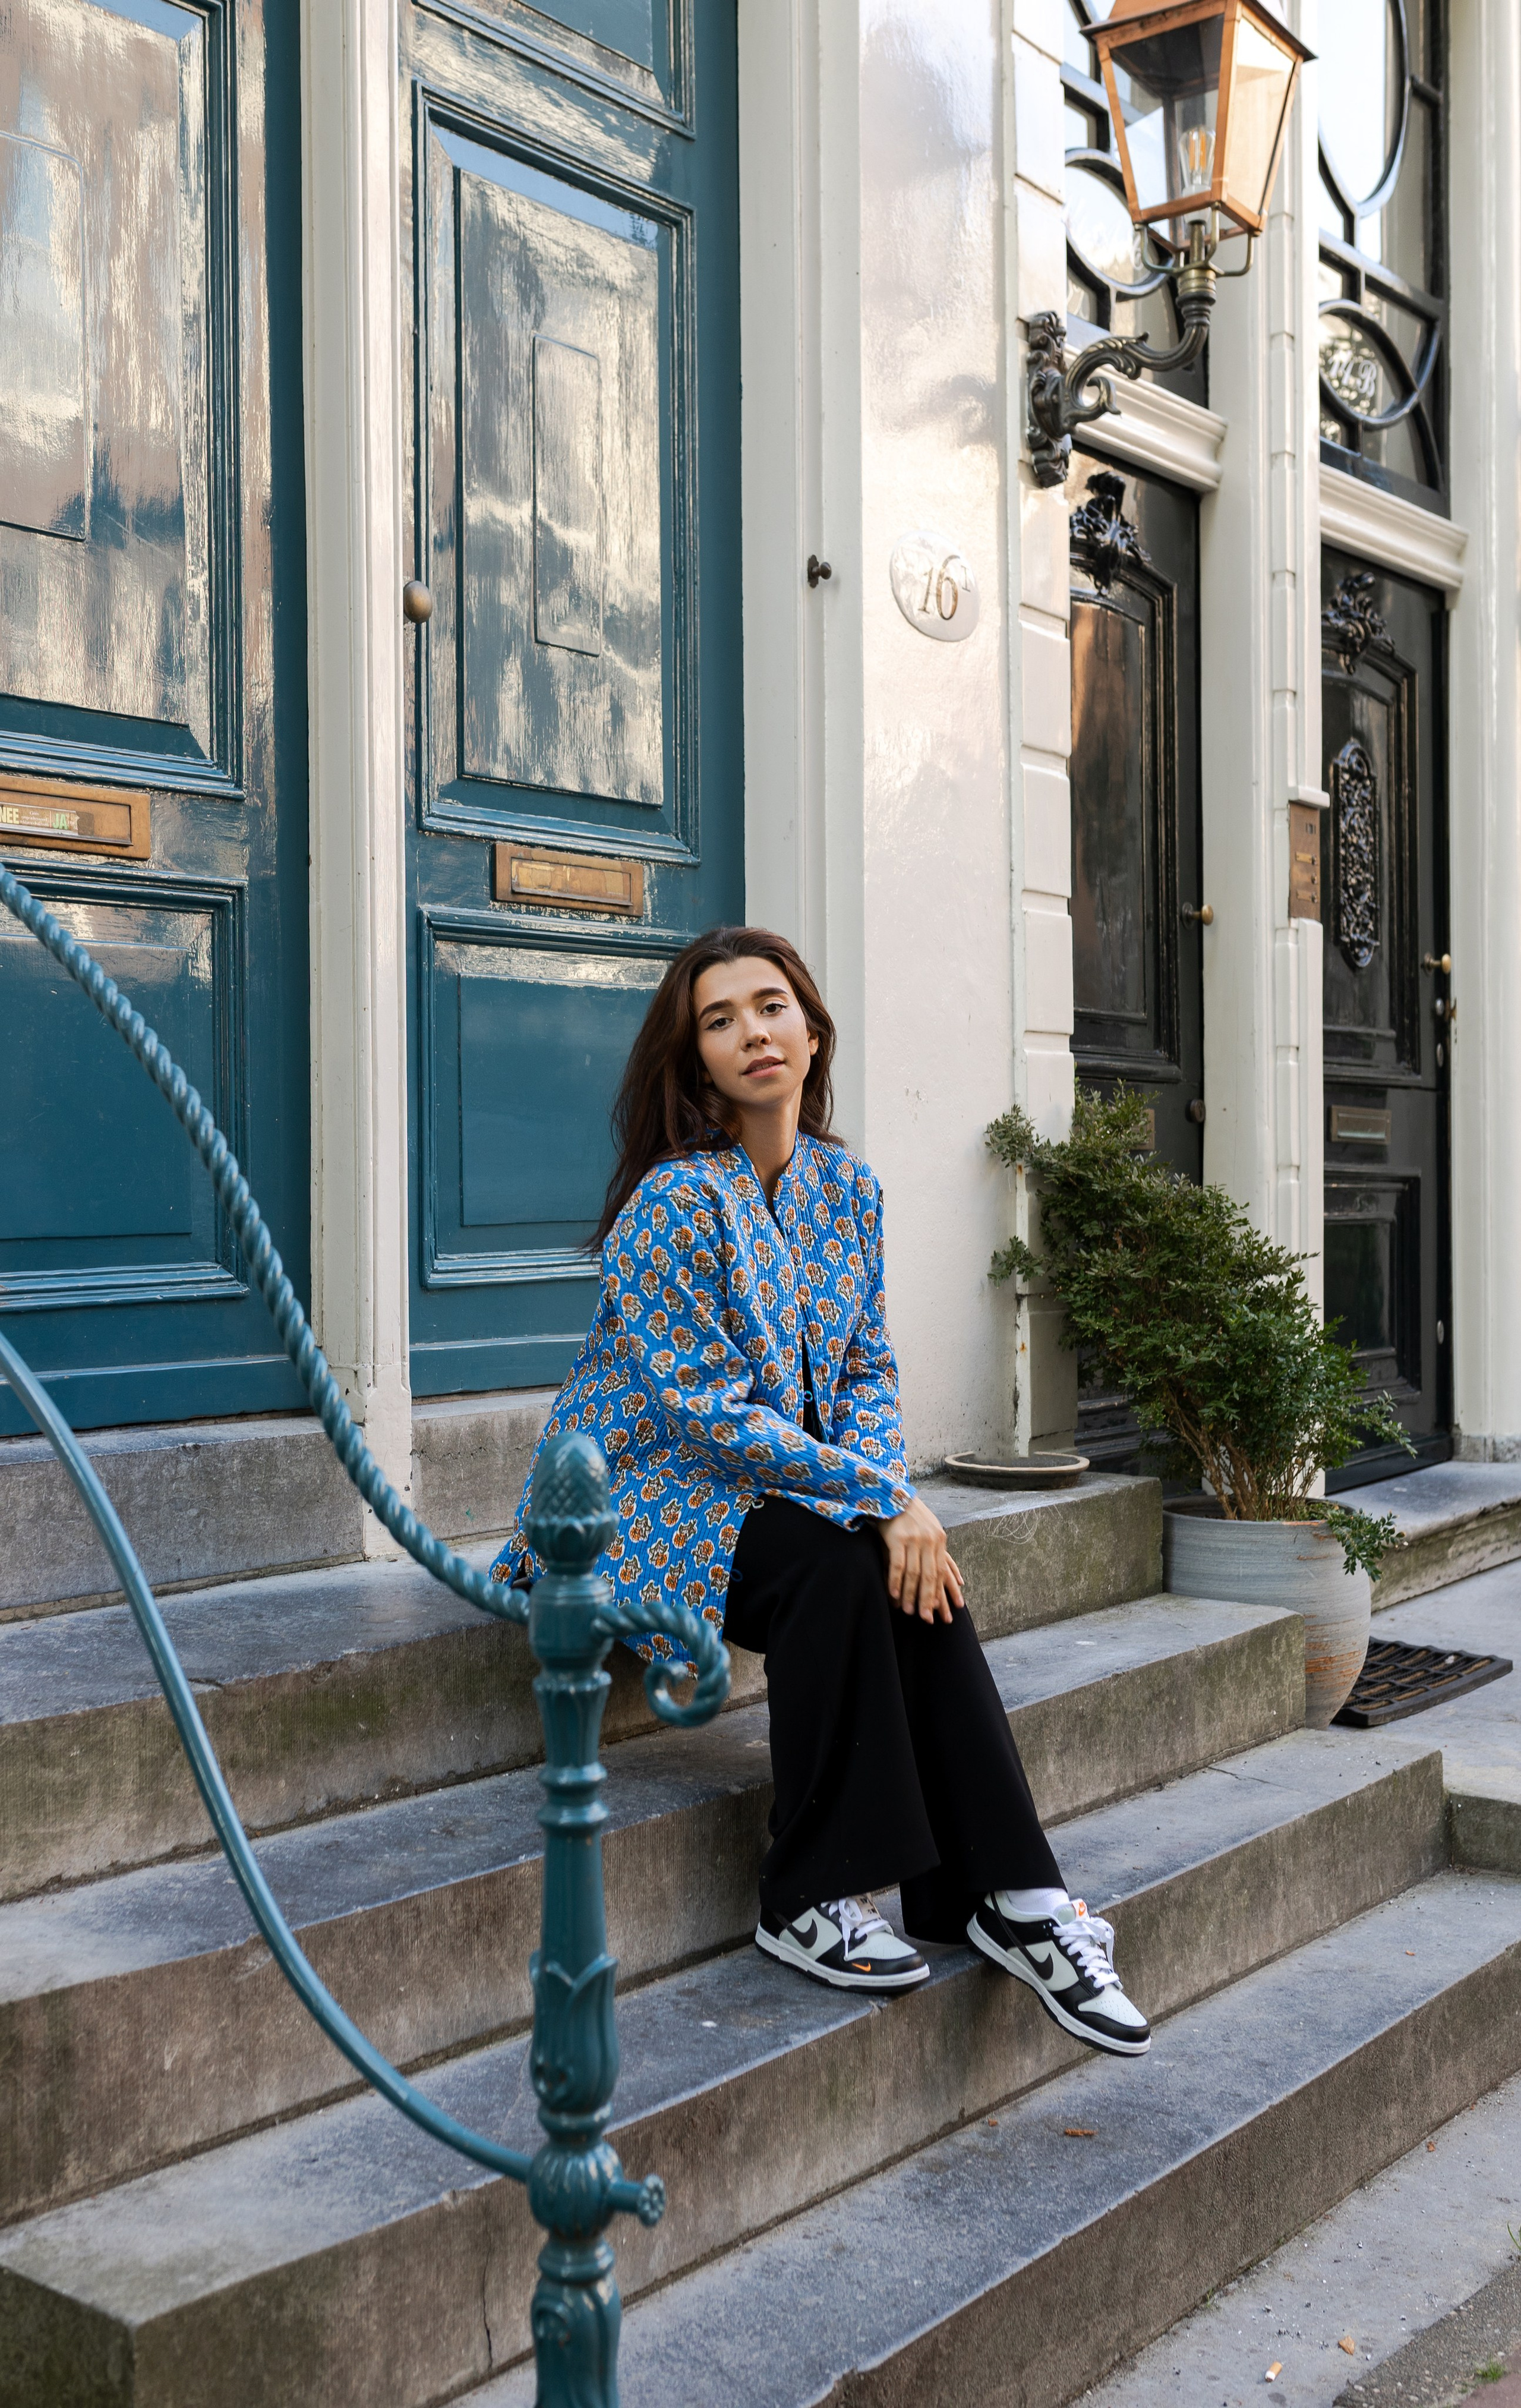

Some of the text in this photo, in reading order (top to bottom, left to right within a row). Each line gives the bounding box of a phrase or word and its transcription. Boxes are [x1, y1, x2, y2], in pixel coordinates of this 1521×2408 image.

[917, 554, 959, 620] 16
[0, 806, 20, 825] NEE
[52, 813, 68, 830] JA
